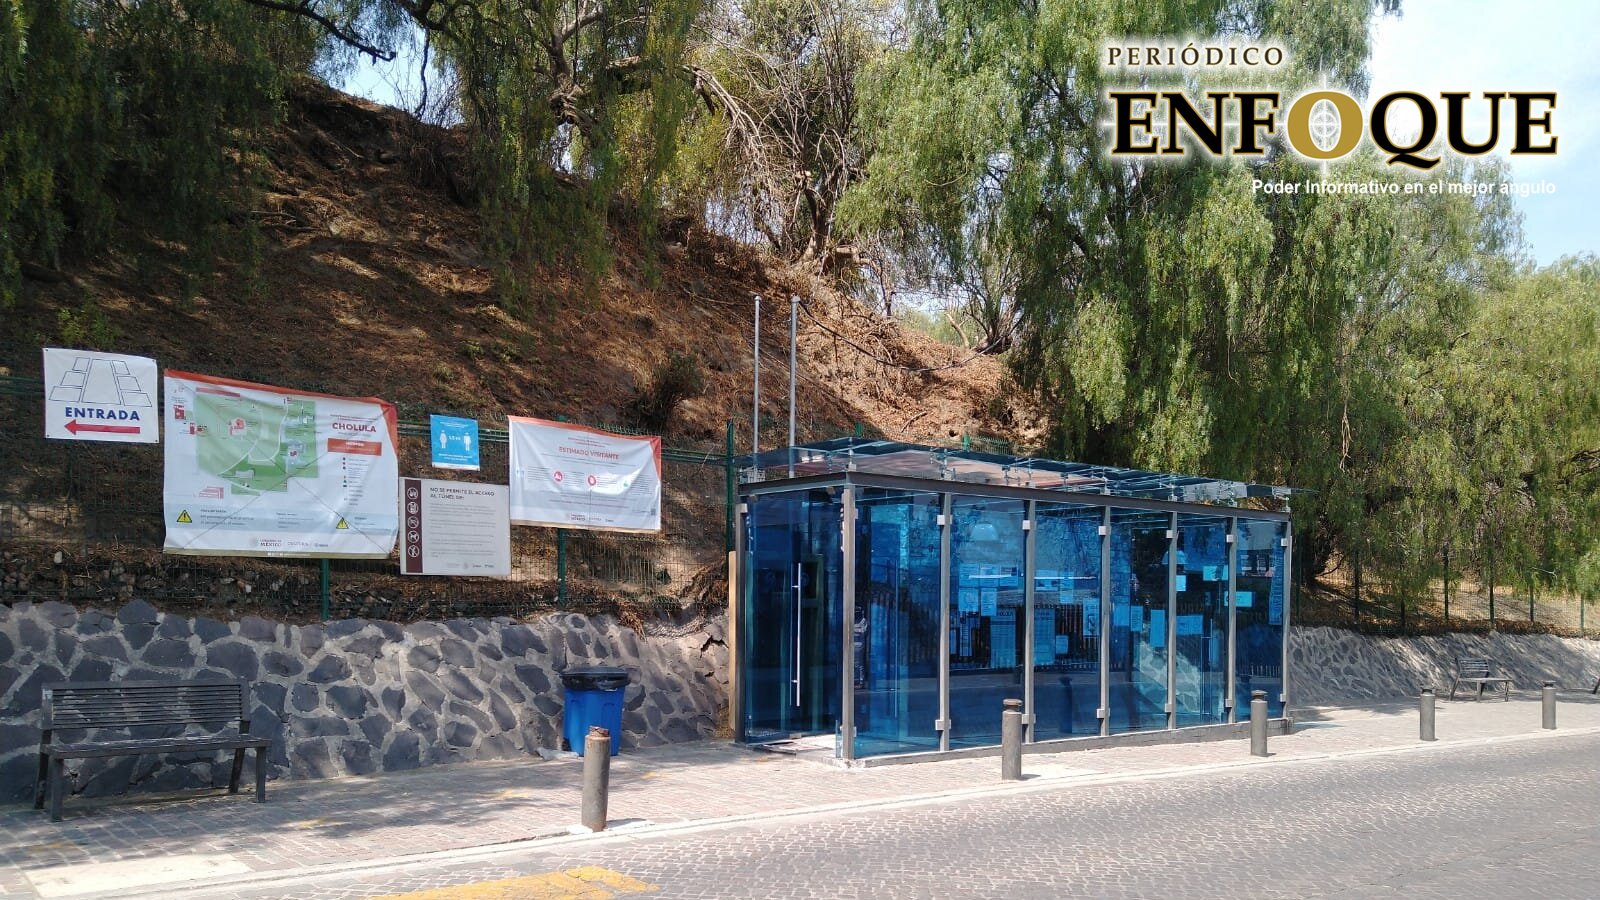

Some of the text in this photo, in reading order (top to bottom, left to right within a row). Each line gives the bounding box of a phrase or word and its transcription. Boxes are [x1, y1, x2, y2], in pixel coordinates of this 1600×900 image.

[65, 407, 140, 421] ENTRADA
[332, 422, 377, 433] CHOLULA
[559, 446, 620, 460] ESTIMADO VISITANTE
